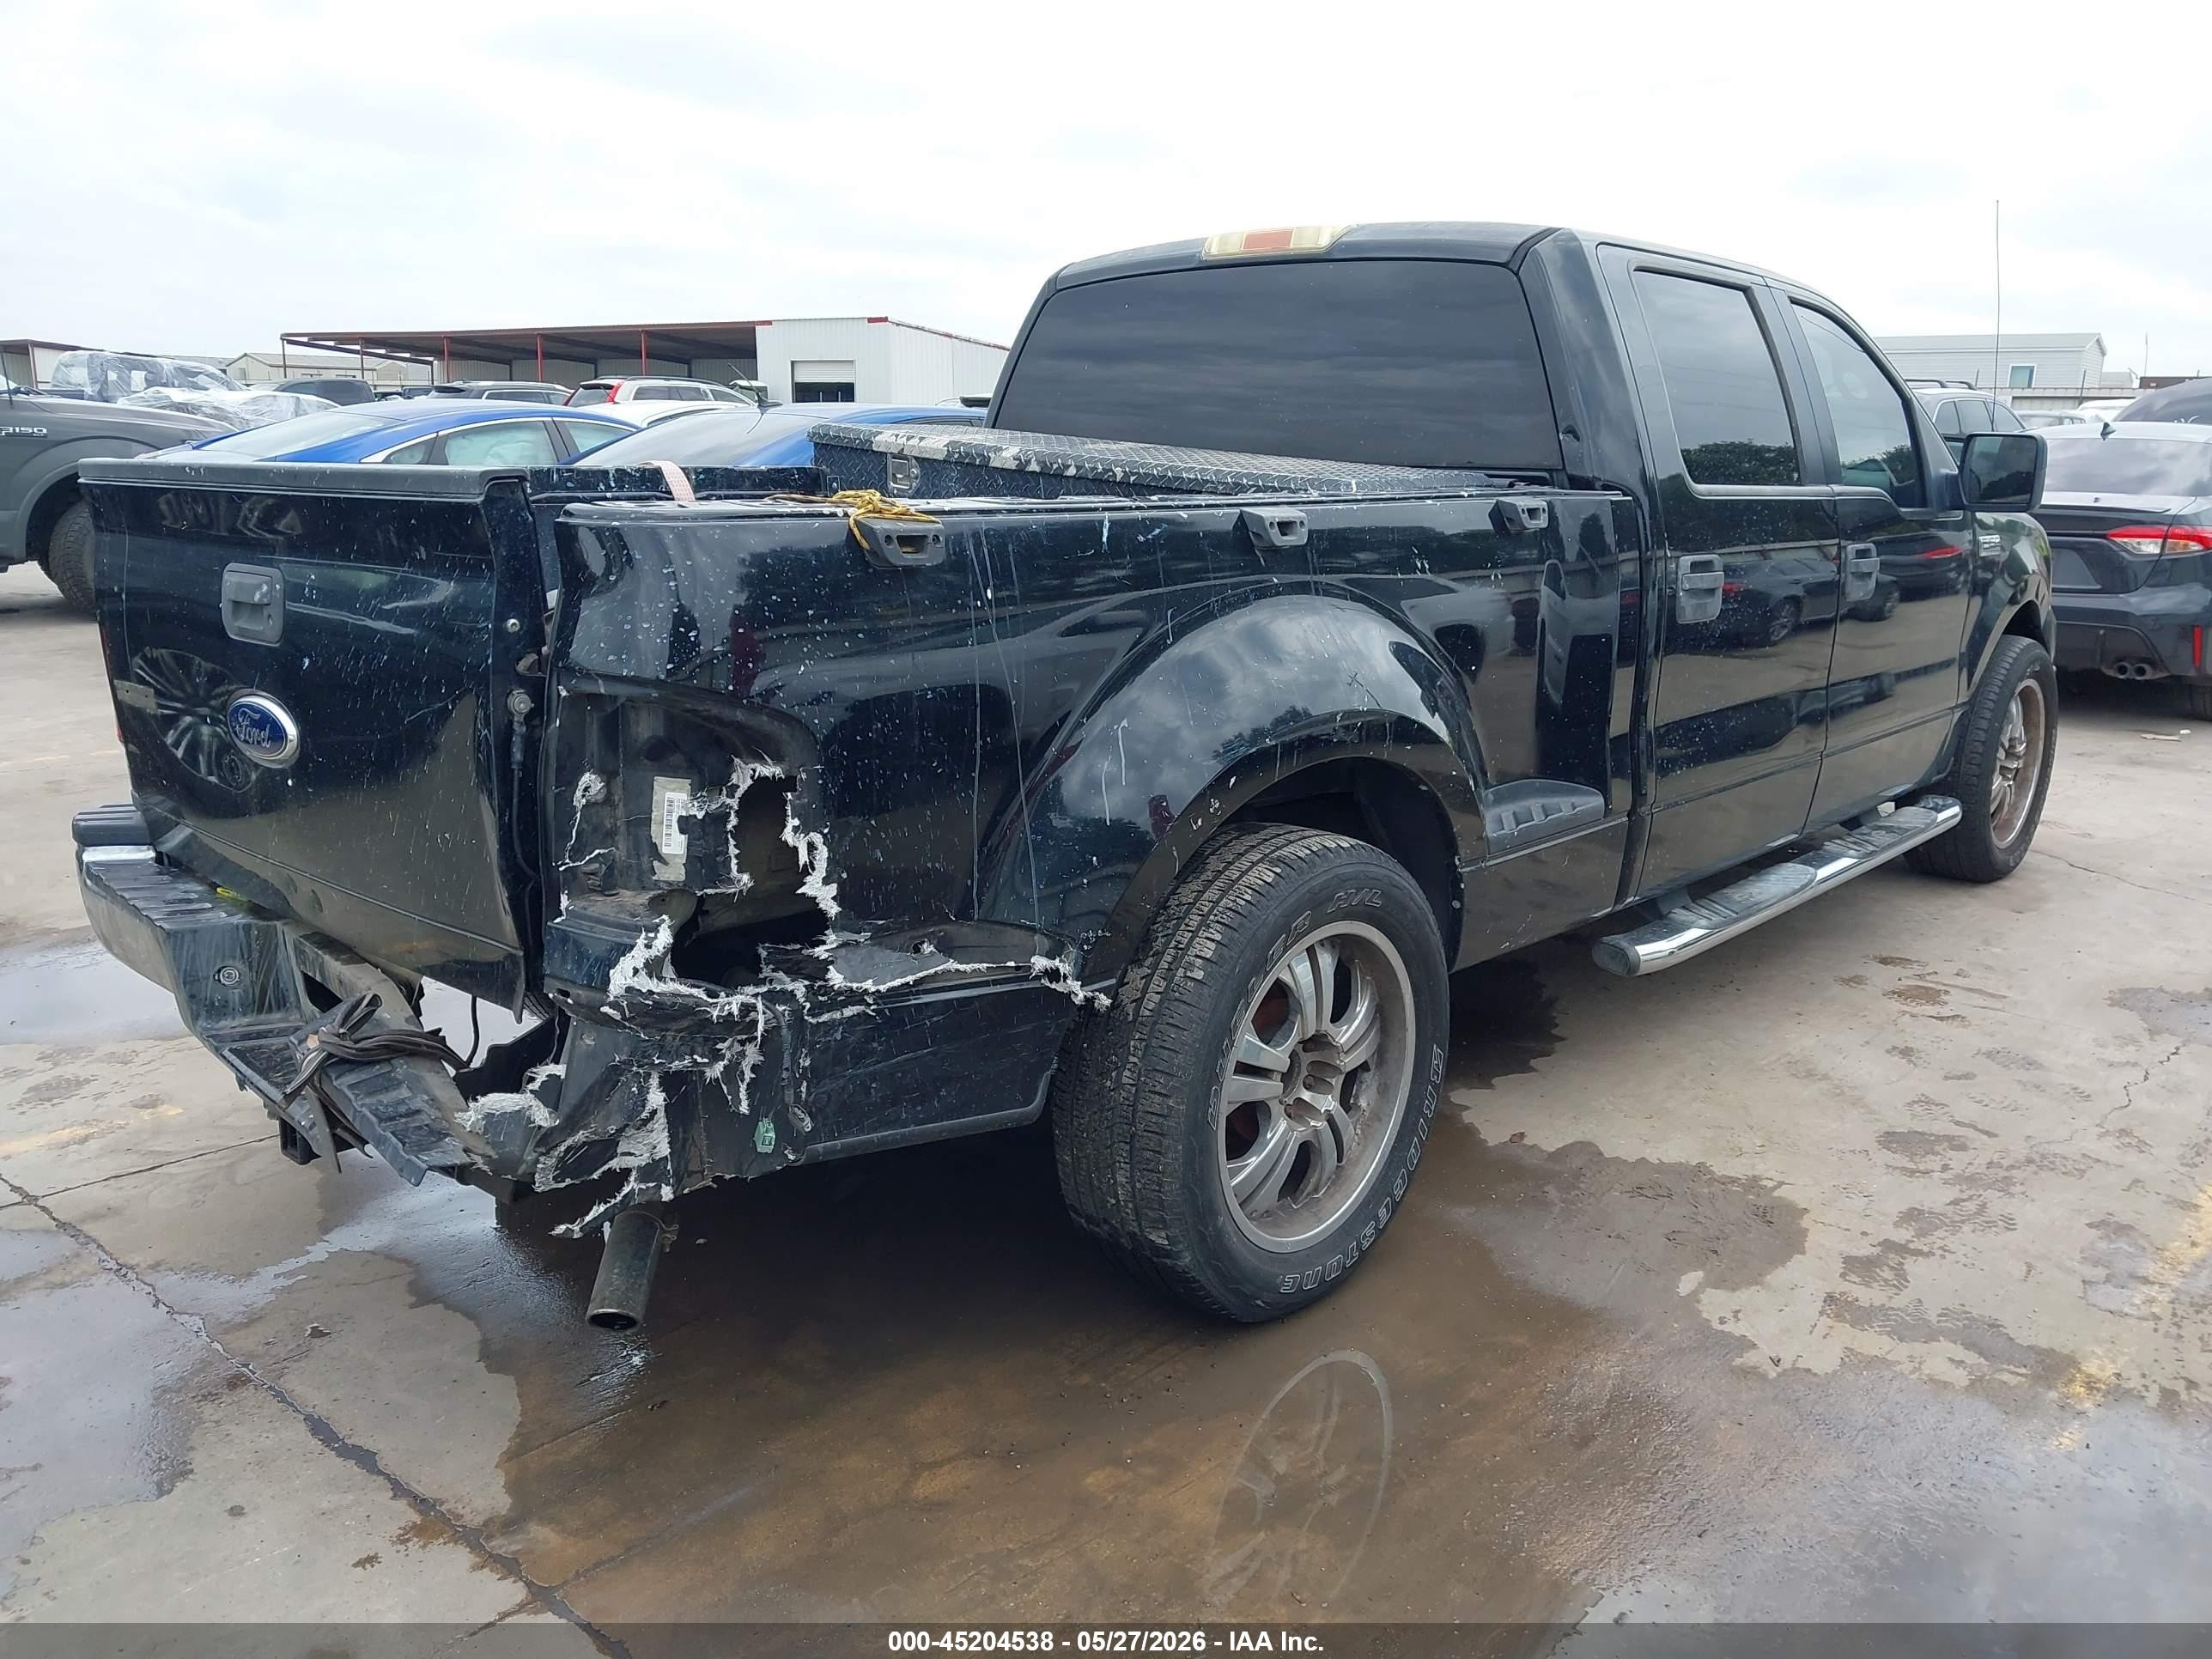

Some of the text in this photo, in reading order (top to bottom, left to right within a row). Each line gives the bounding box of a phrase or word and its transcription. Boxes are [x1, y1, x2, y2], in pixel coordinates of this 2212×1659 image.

[235, 708, 272, 748] Ford
[1206, 909, 1313, 1131] DUELER
[1279, 1043, 1444, 1294] BRIDGESTONE
